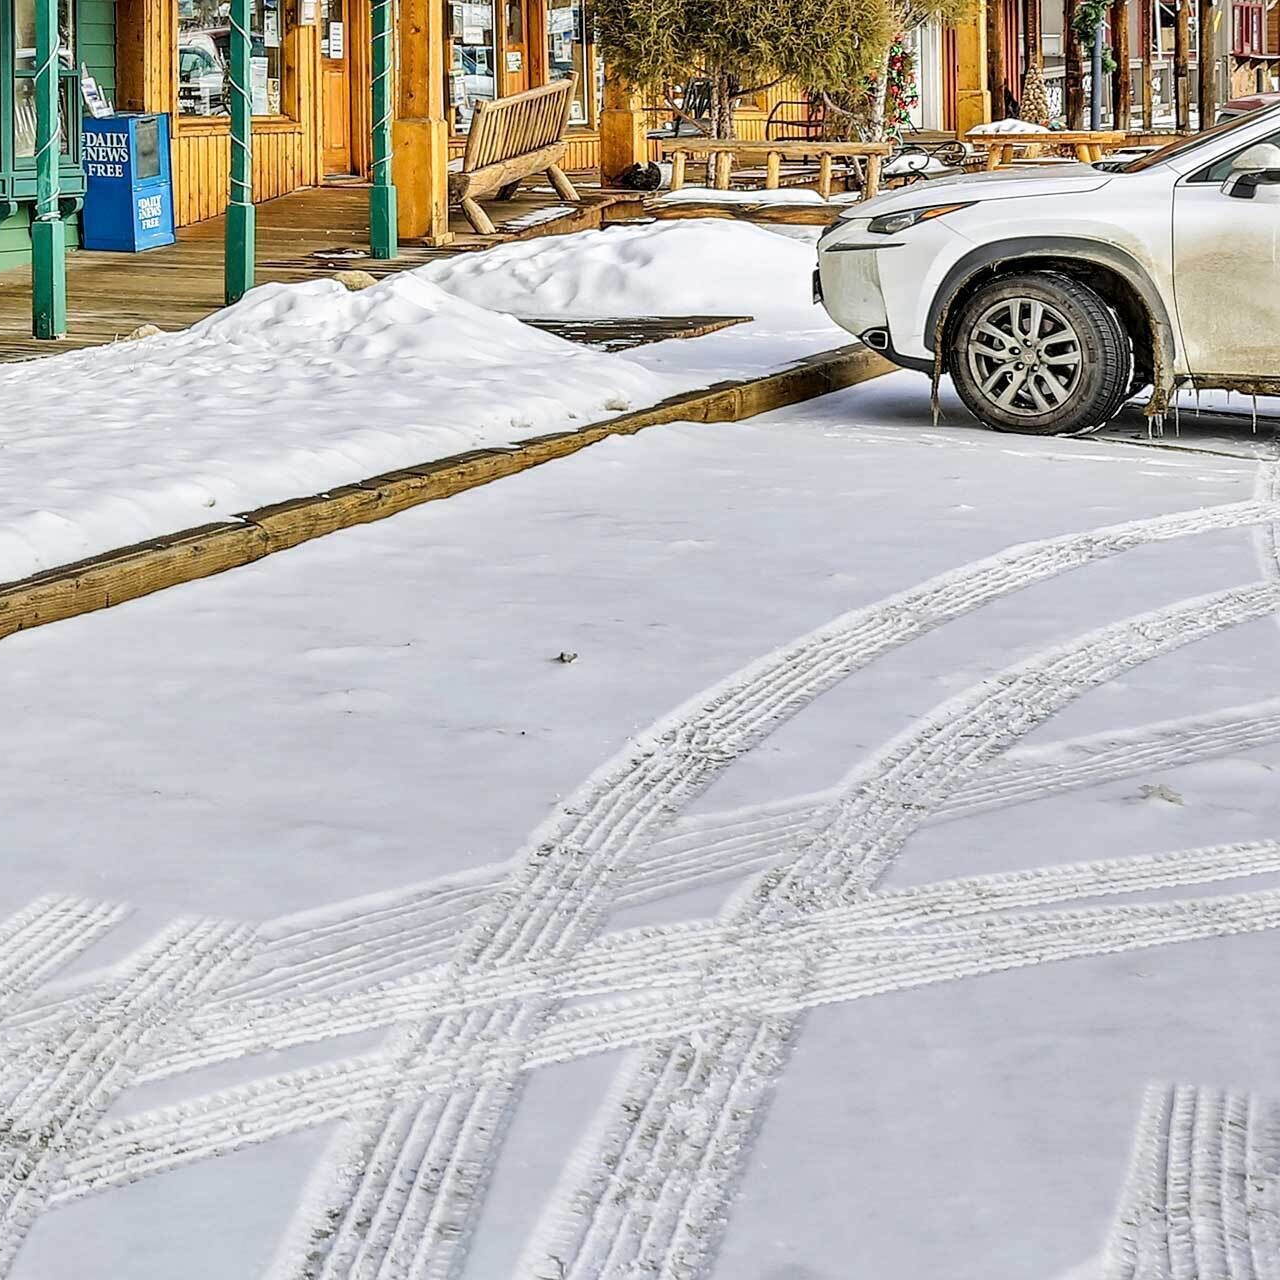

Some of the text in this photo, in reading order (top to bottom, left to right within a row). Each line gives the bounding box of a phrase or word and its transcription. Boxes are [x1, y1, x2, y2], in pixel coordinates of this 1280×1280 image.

[85, 132, 129, 147] DAILY
[86, 147, 129, 162] NEWS
[88, 163, 124, 177] FREE
[141, 194, 162, 208] DAILY
[141, 206, 162, 219] NEWS
